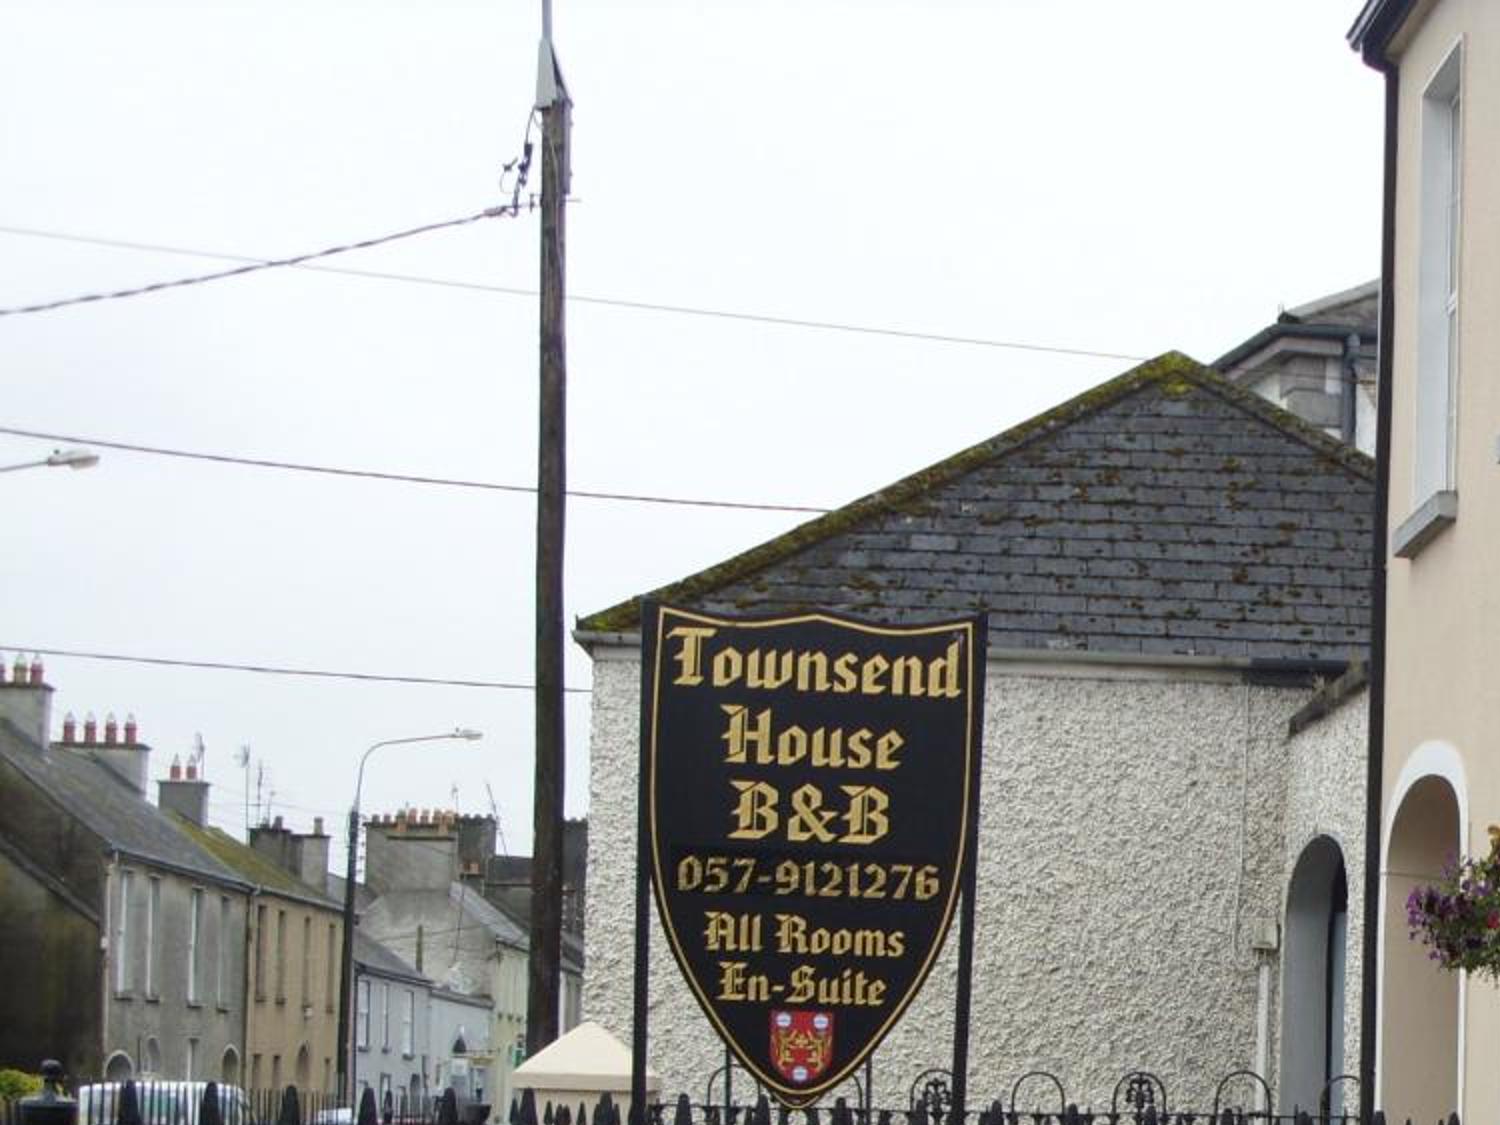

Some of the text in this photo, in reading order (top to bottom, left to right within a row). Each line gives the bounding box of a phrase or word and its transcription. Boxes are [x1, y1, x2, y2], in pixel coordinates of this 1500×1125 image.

[666, 627, 962, 698] Townsend
[722, 704, 904, 768] House
[728, 780, 889, 843] B&B
[677, 856, 939, 899] 057-9121276
[704, 911, 905, 958] All Rooms
[718, 962, 887, 1005] En-Suite
